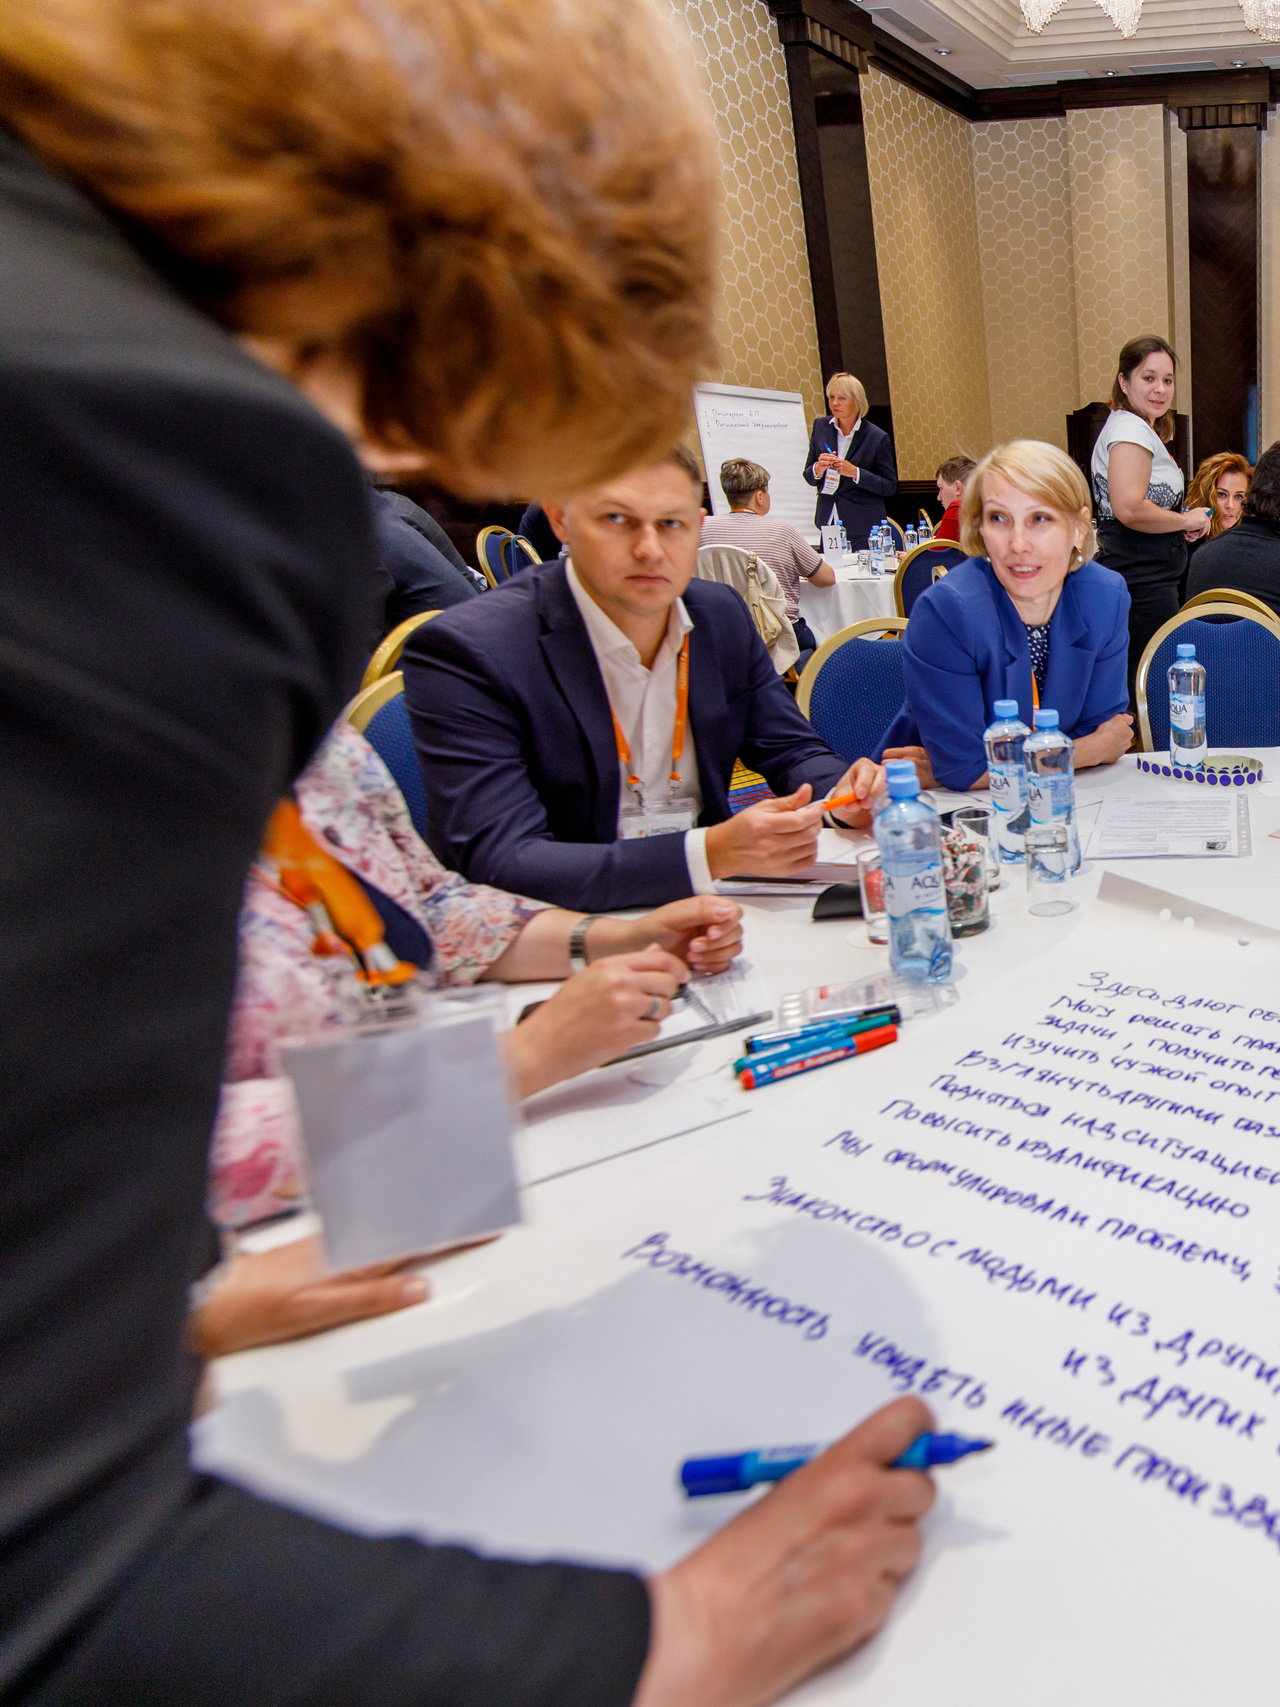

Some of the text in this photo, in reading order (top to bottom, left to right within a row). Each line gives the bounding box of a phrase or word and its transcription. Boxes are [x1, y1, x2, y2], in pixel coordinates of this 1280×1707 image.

[828, 537, 839, 549] 21
[1171, 703, 1188, 715] QUA
[990, 777, 1011, 790] QUA
